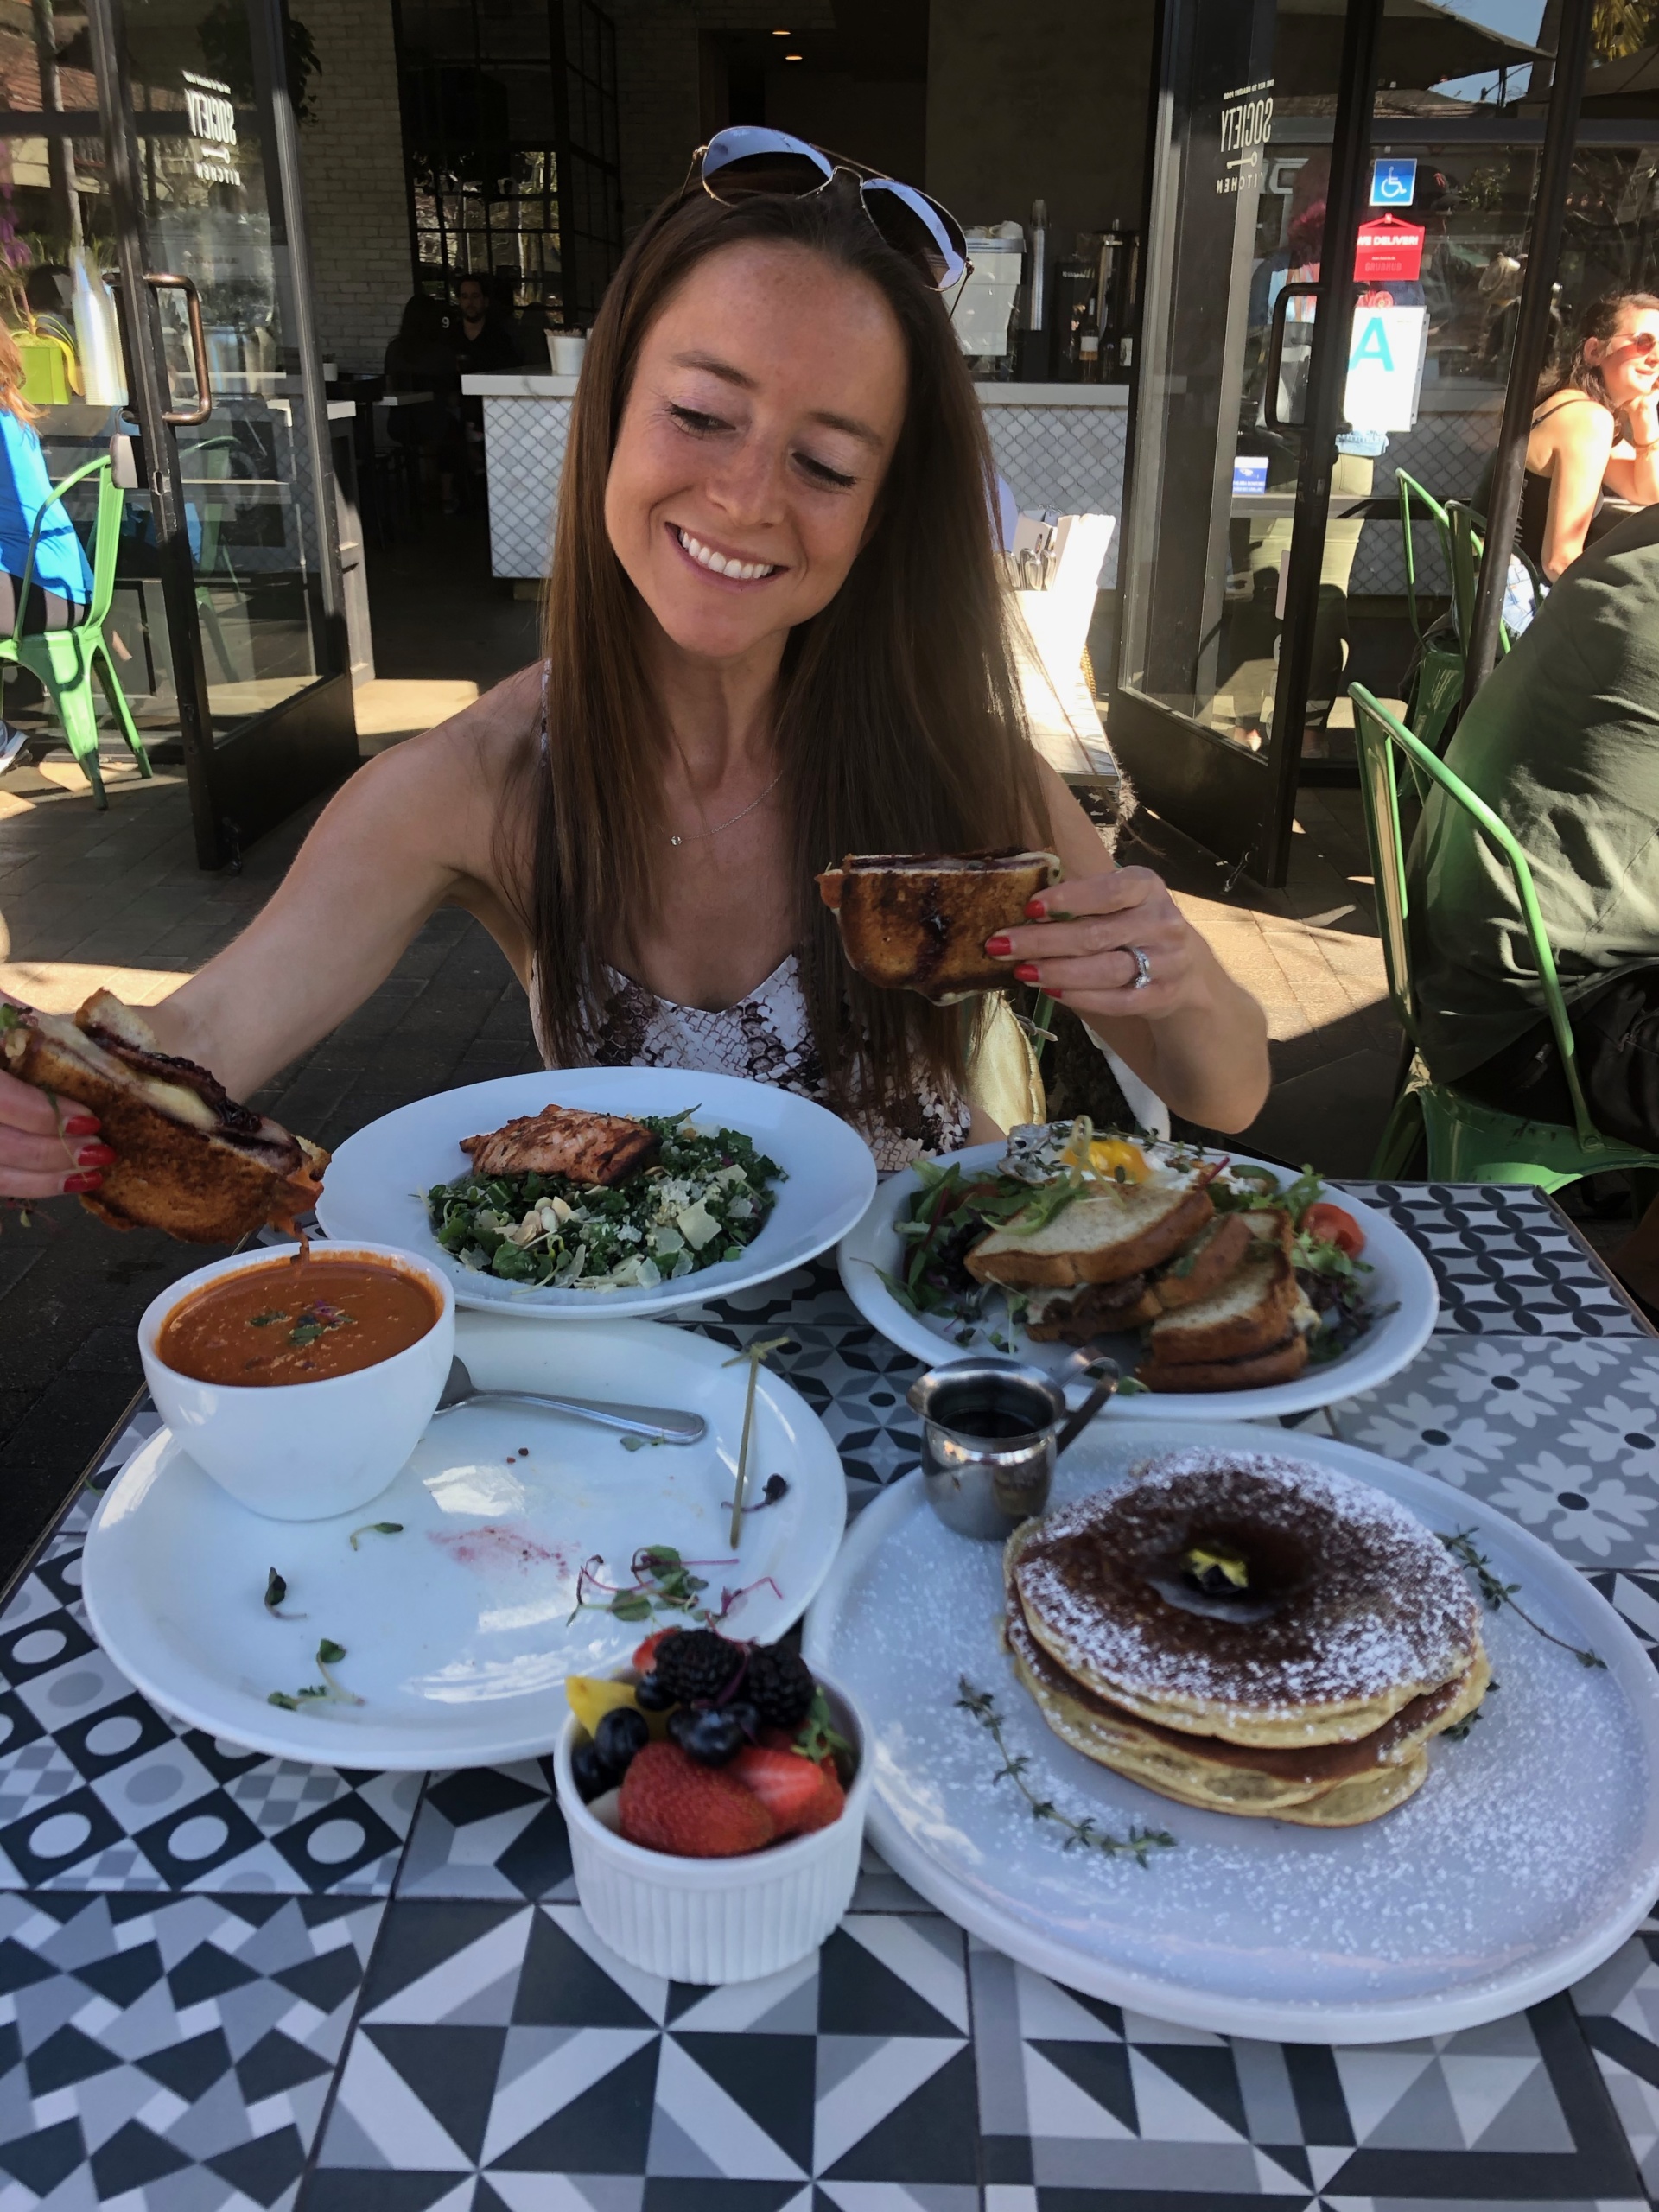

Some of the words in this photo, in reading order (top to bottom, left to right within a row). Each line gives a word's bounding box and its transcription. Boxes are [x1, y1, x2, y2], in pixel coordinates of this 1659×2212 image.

[1372, 235, 1419, 246] DELIVER!
[442, 316, 450, 328] 9
[1349, 317, 1395, 372] A
